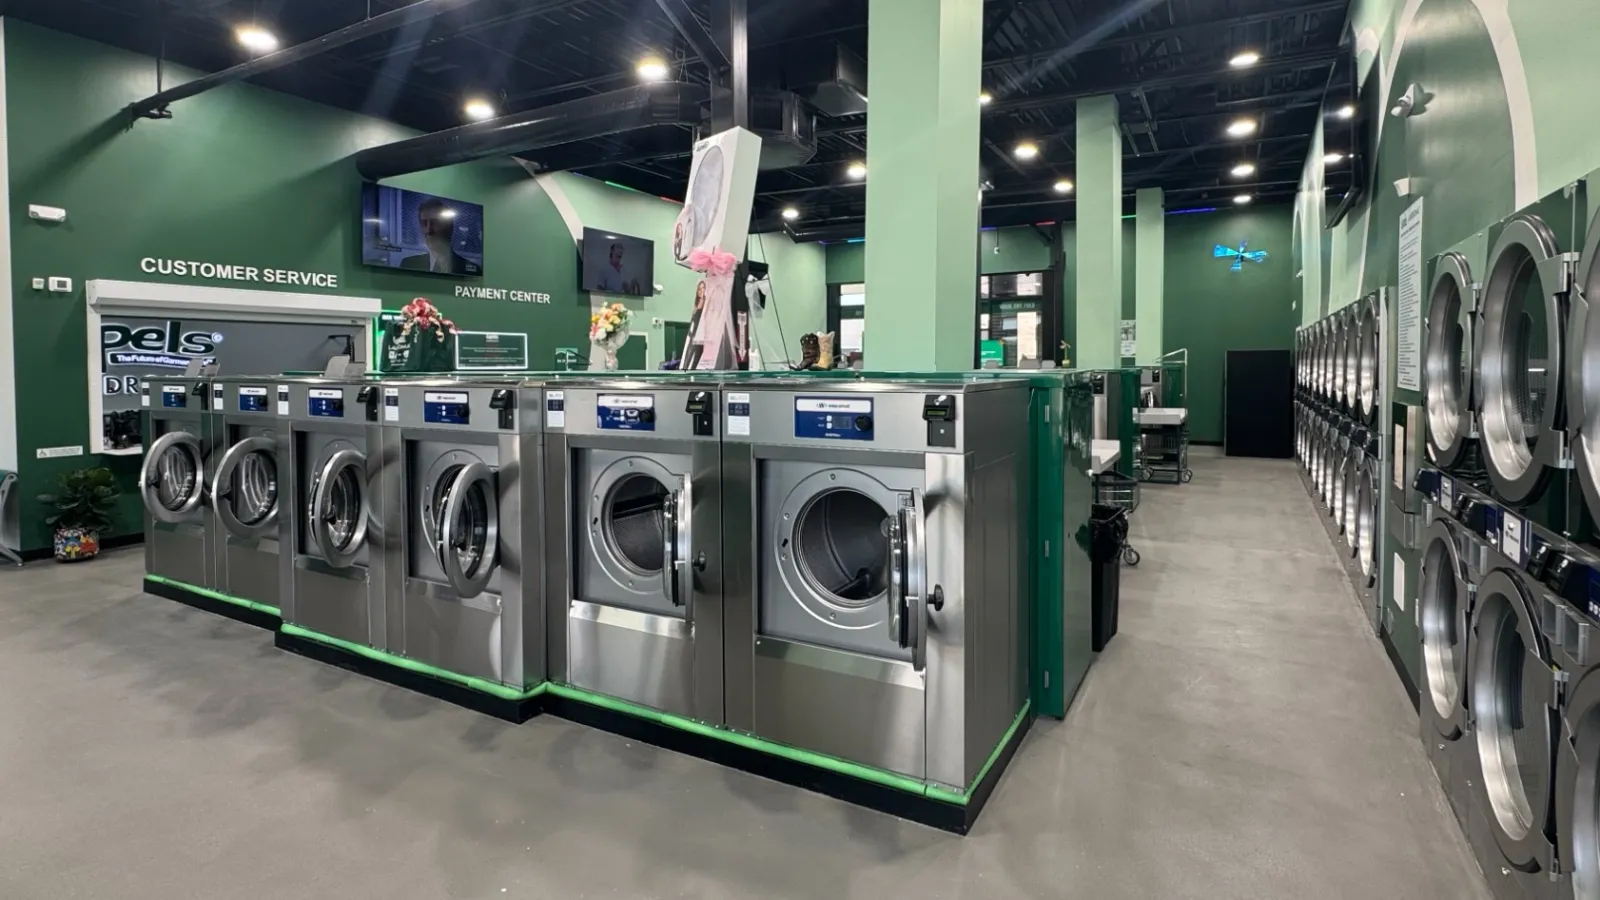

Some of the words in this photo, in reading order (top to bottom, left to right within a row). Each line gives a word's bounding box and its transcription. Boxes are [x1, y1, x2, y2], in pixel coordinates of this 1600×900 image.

[140, 257, 259, 282] CUSTOMER
[263, 268, 338, 288] SERVICE
[455, 285, 508, 300] PAYMENT
[509, 290, 551, 304] CENTER
[116, 355, 132, 363] The
[132, 355, 155, 364] Future
[163, 356, 190, 366] Garmen
